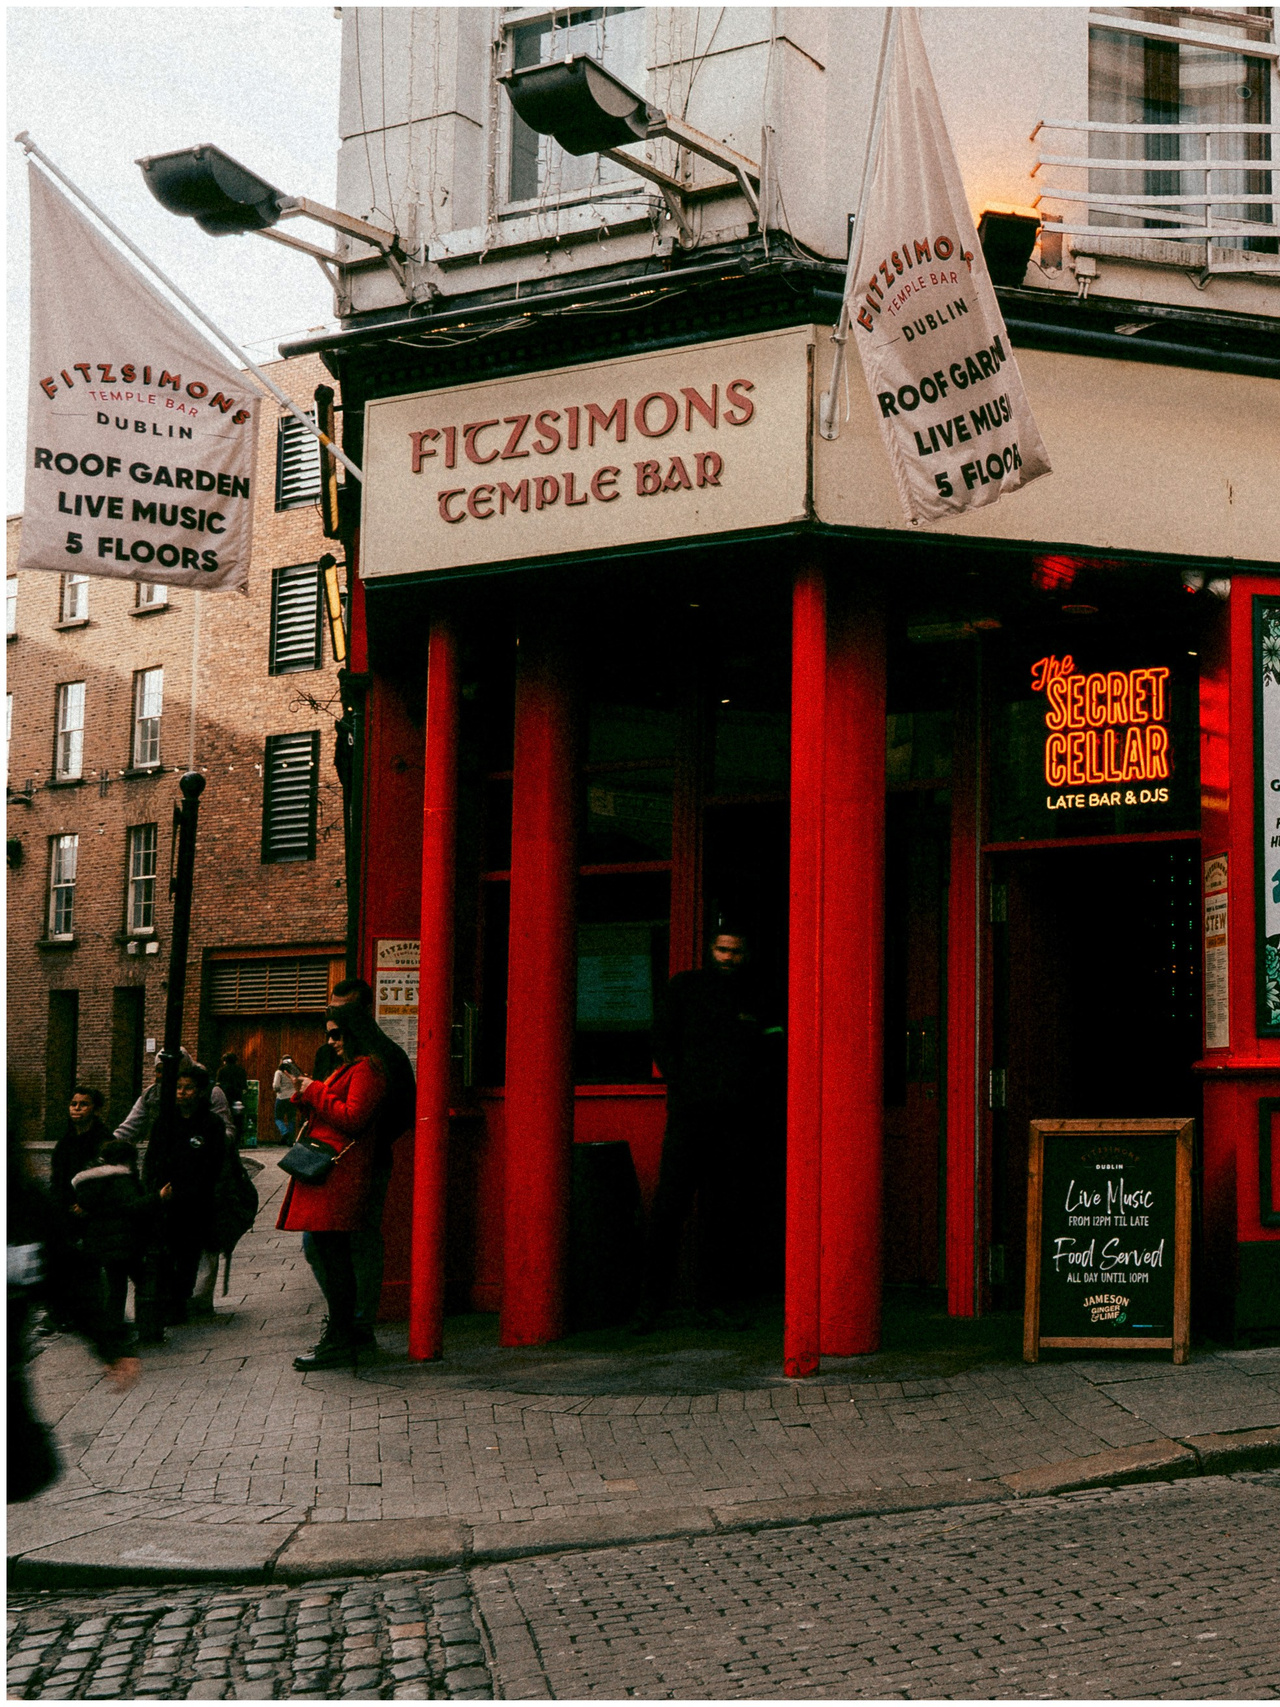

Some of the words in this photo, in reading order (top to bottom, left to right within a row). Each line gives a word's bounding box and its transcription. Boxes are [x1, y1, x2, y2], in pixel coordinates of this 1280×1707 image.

[887, 278, 927, 317] TEMPLE
[930, 271, 959, 285] BAR
[902, 297, 969, 342] DUBLIN
[39, 362, 251, 426] FITZSIMONS
[88, 390, 157, 405] TEMPLE
[165, 398, 199, 419] BAR
[877, 369, 950, 418] ROOF
[96, 411, 193, 440] DUBLIN
[408, 379, 756, 474] FITZSIMONS
[913, 415, 972, 457] LIVE
[34, 446, 122, 479] ROOF
[129, 461, 251, 500] GARDEN
[437, 465, 621, 523] TEMPLE
[634, 450, 724, 497] BAR
[935, 471, 954, 498] 5
[58, 490, 124, 521] LIVE
[132, 499, 226, 535] MUSIC
[65, 532, 83, 555] 5
[97, 536, 219, 573] FLOORS
[1031, 655, 1075, 691] The
[1045, 667, 1170, 730] SECRET
[1045, 725, 1169, 787] CELLAR
[1047, 794, 1085, 809] LATE
[1089, 792, 1121, 807] BAR
[1125, 790, 1137, 805] &
[1140, 788, 1169, 803] DJS
[380, 987, 419, 1001] STE
[1064, 1179, 1101, 1212] Live
[1107, 1178, 1154, 1214] Music
[1068, 1216, 1090, 1227] FROM
[1092, 1216, 1111, 1227] 12PM
[1114, 1216, 1127, 1227] TIL
[1130, 1216, 1149, 1227] LATE
[1053, 1237, 1096, 1272] Food
[1100, 1237, 1165, 1271] Served
[1067, 1272, 1081, 1283] ALL
[1084, 1272, 1098, 1283] DAY
[1101, 1272, 1126, 1283] UNTIL
[1129, 1272, 1149, 1283] 10PM
[1083, 1294, 1130, 1307] JAMESON
[1091, 1305, 1120, 1314] GINGER
